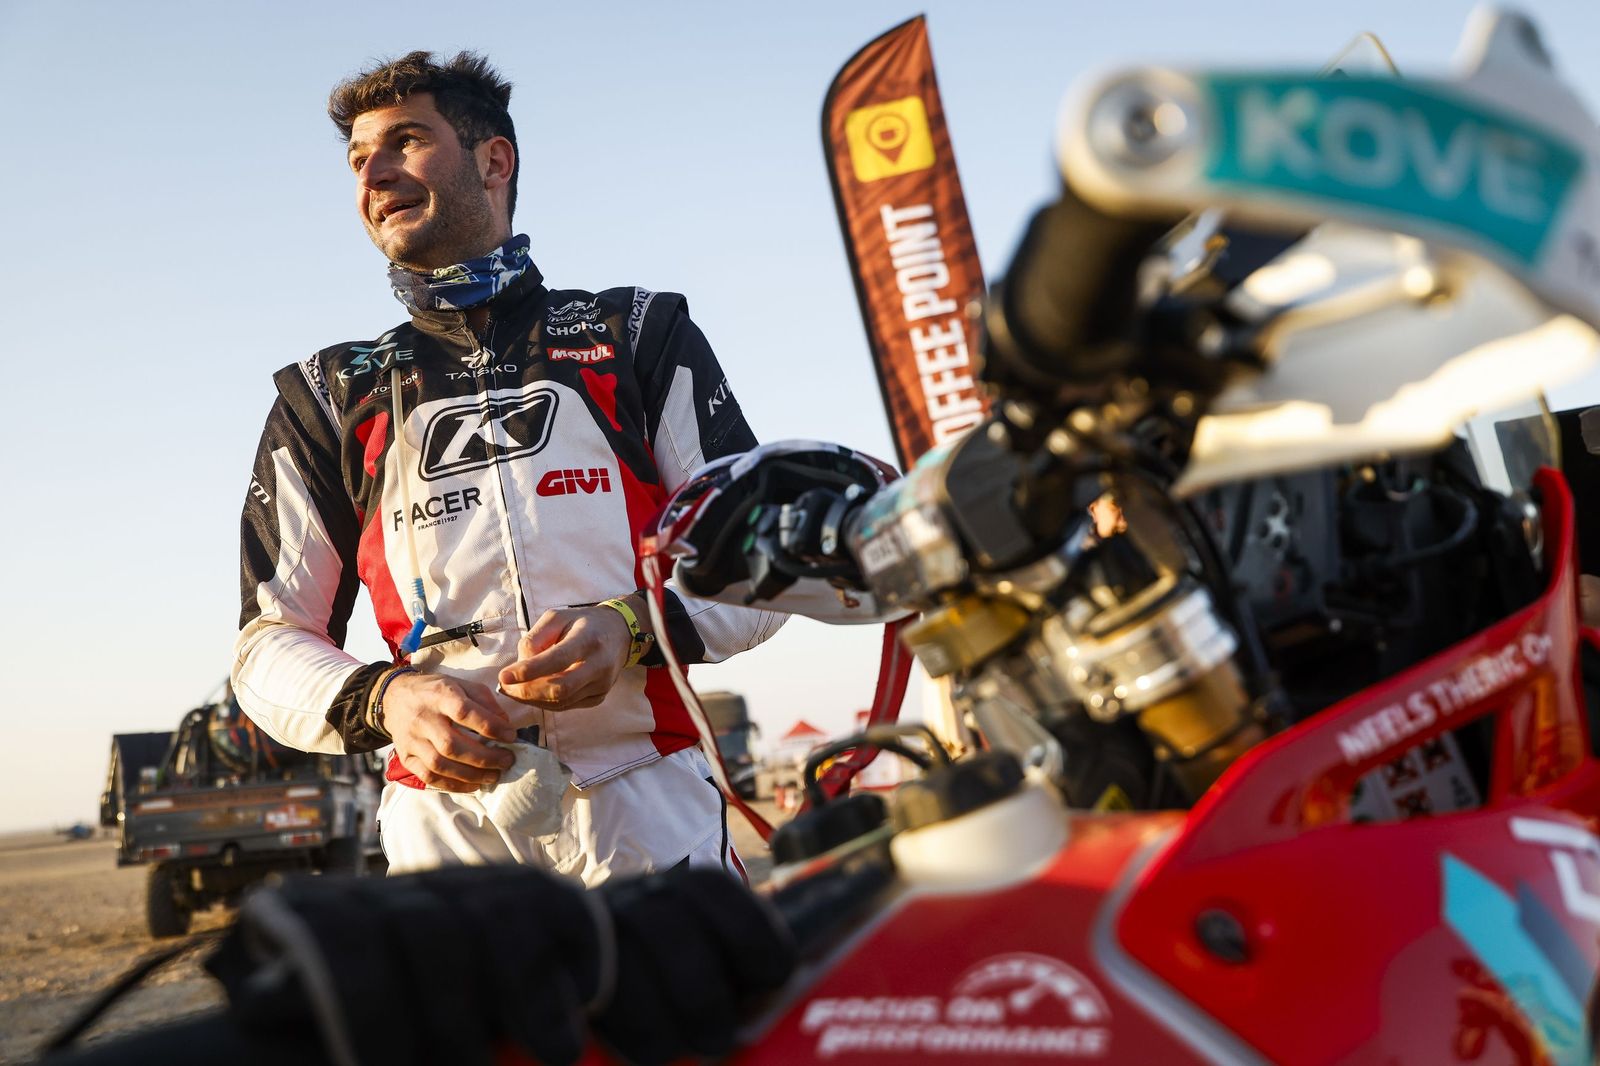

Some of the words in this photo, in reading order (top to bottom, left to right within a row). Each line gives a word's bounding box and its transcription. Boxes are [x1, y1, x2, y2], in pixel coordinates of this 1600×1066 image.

[1238, 84, 1546, 223] KOVE
[881, 203, 957, 321] POINT
[551, 345, 611, 361] MOTUL
[910, 319, 985, 447] OFFEE
[536, 468, 611, 497] GIVI
[801, 996, 938, 1031] FOCUS
[946, 996, 1005, 1022] ON
[817, 1024, 1109, 1058] PERFORMANCE
